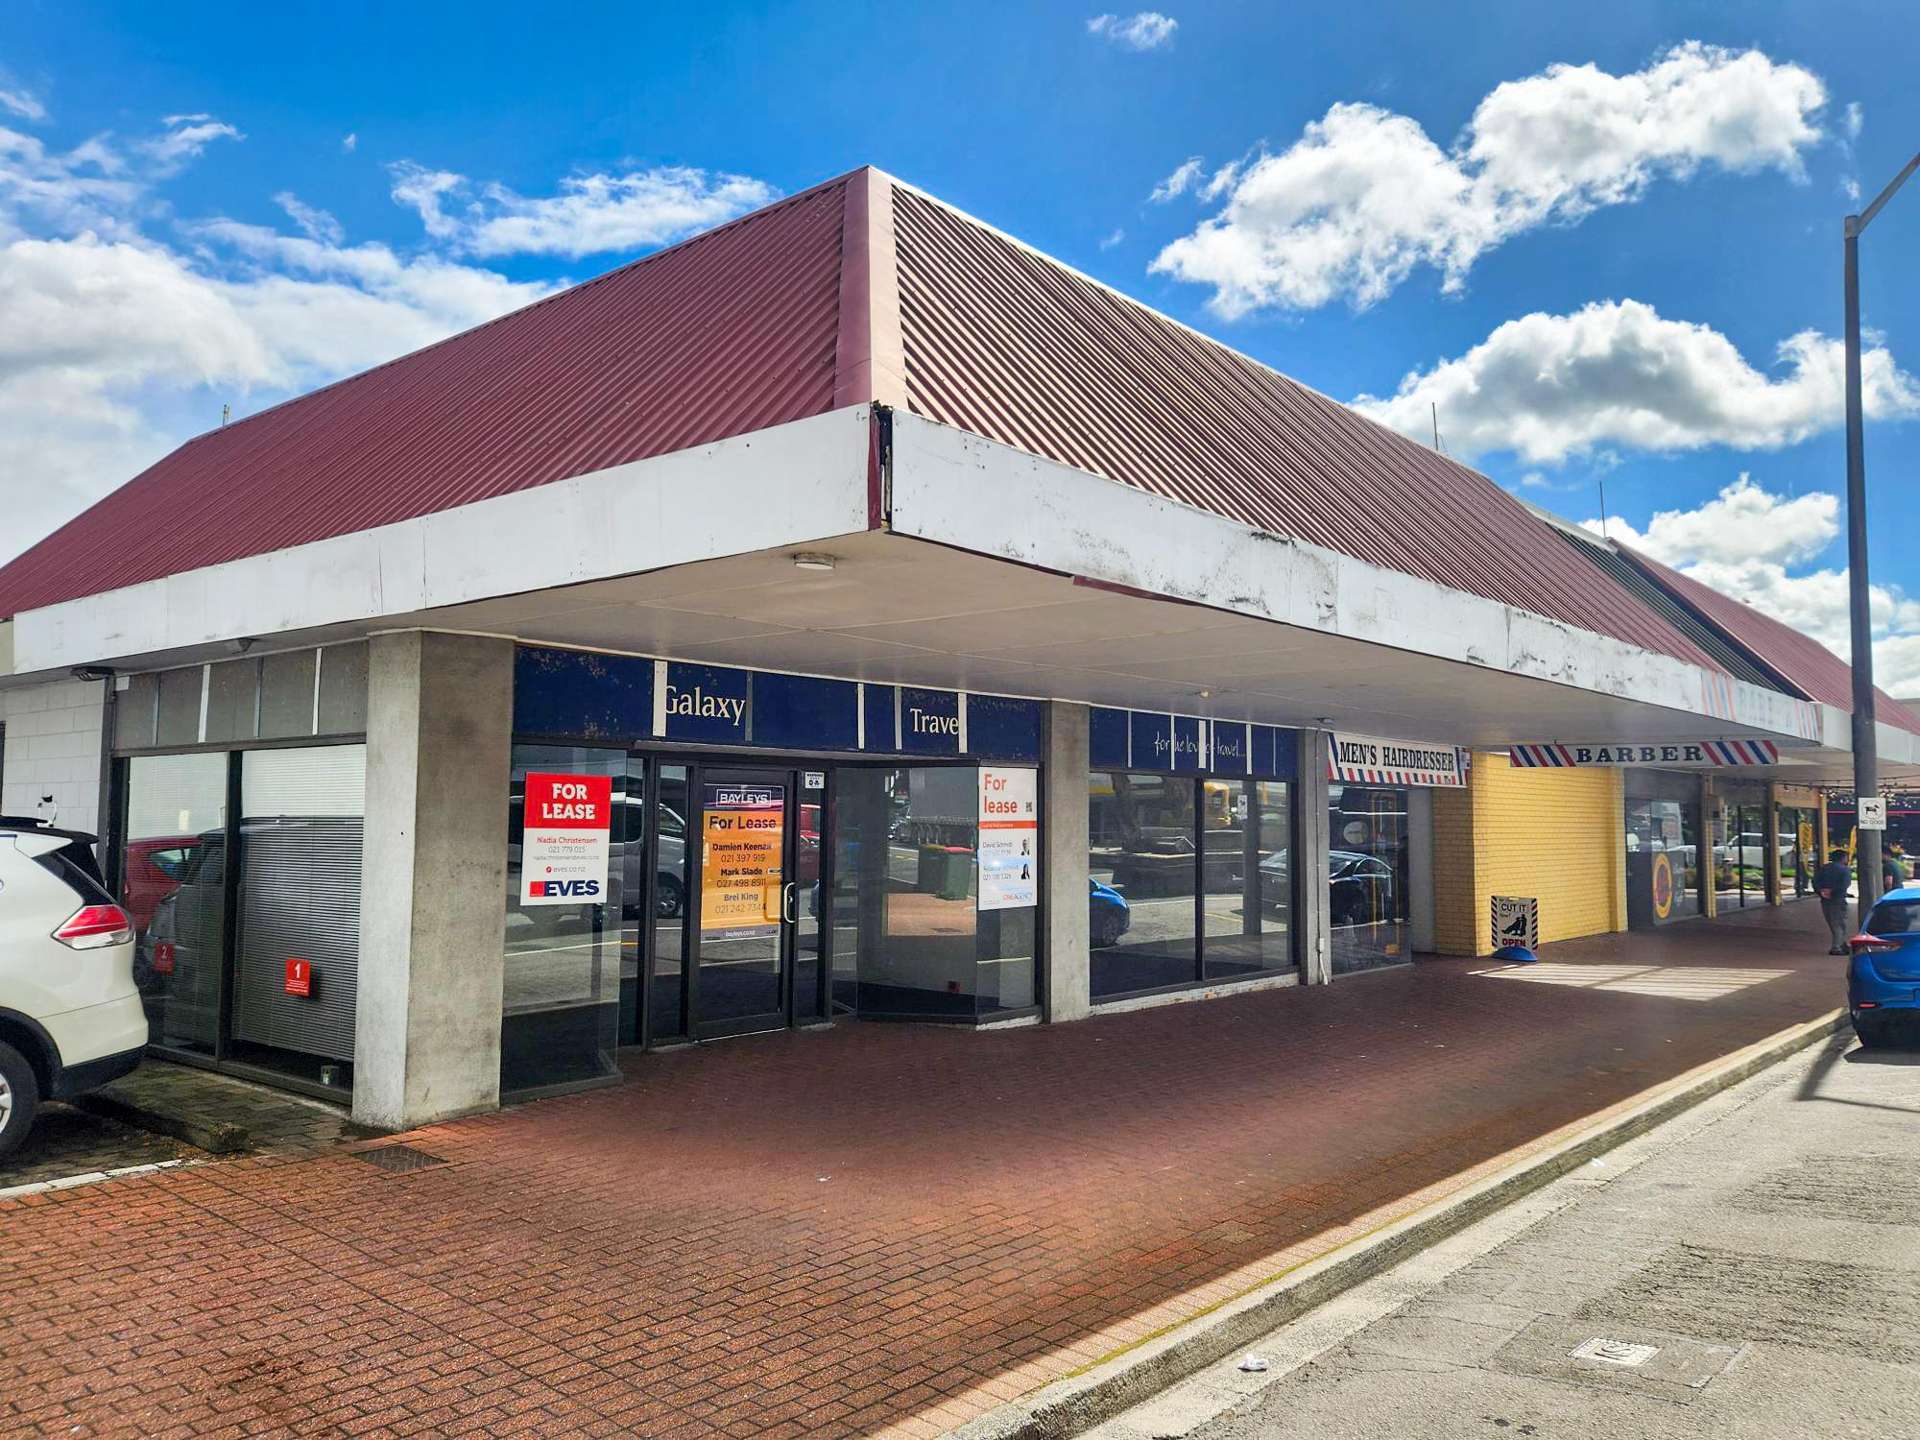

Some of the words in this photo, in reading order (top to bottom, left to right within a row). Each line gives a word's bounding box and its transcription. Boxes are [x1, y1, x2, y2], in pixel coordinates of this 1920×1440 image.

[666, 685, 746, 726] Galaxy
[909, 707, 959, 735] Trave
[1340, 742, 1377, 766] MEN'S
[1382, 746, 1455, 772] HAIRDRESSER
[1576, 746, 1704, 763] BARBER
[984, 773, 1007, 791] For
[552, 783, 588, 800] FOR
[719, 793, 768, 804] BAYLEYS
[542, 803, 595, 819] LEASE
[984, 795, 1018, 814] lease
[709, 815, 733, 830] For
[738, 815, 777, 830] Lease
[712, 842, 742, 851] Damien
[720, 854, 735, 863] 021
[720, 868, 739, 876] Mark
[741, 867, 763, 875] Slade
[545, 880, 599, 897] EVES
[1501, 903, 1516, 912] CUT
[294, 963, 301, 979] 1
